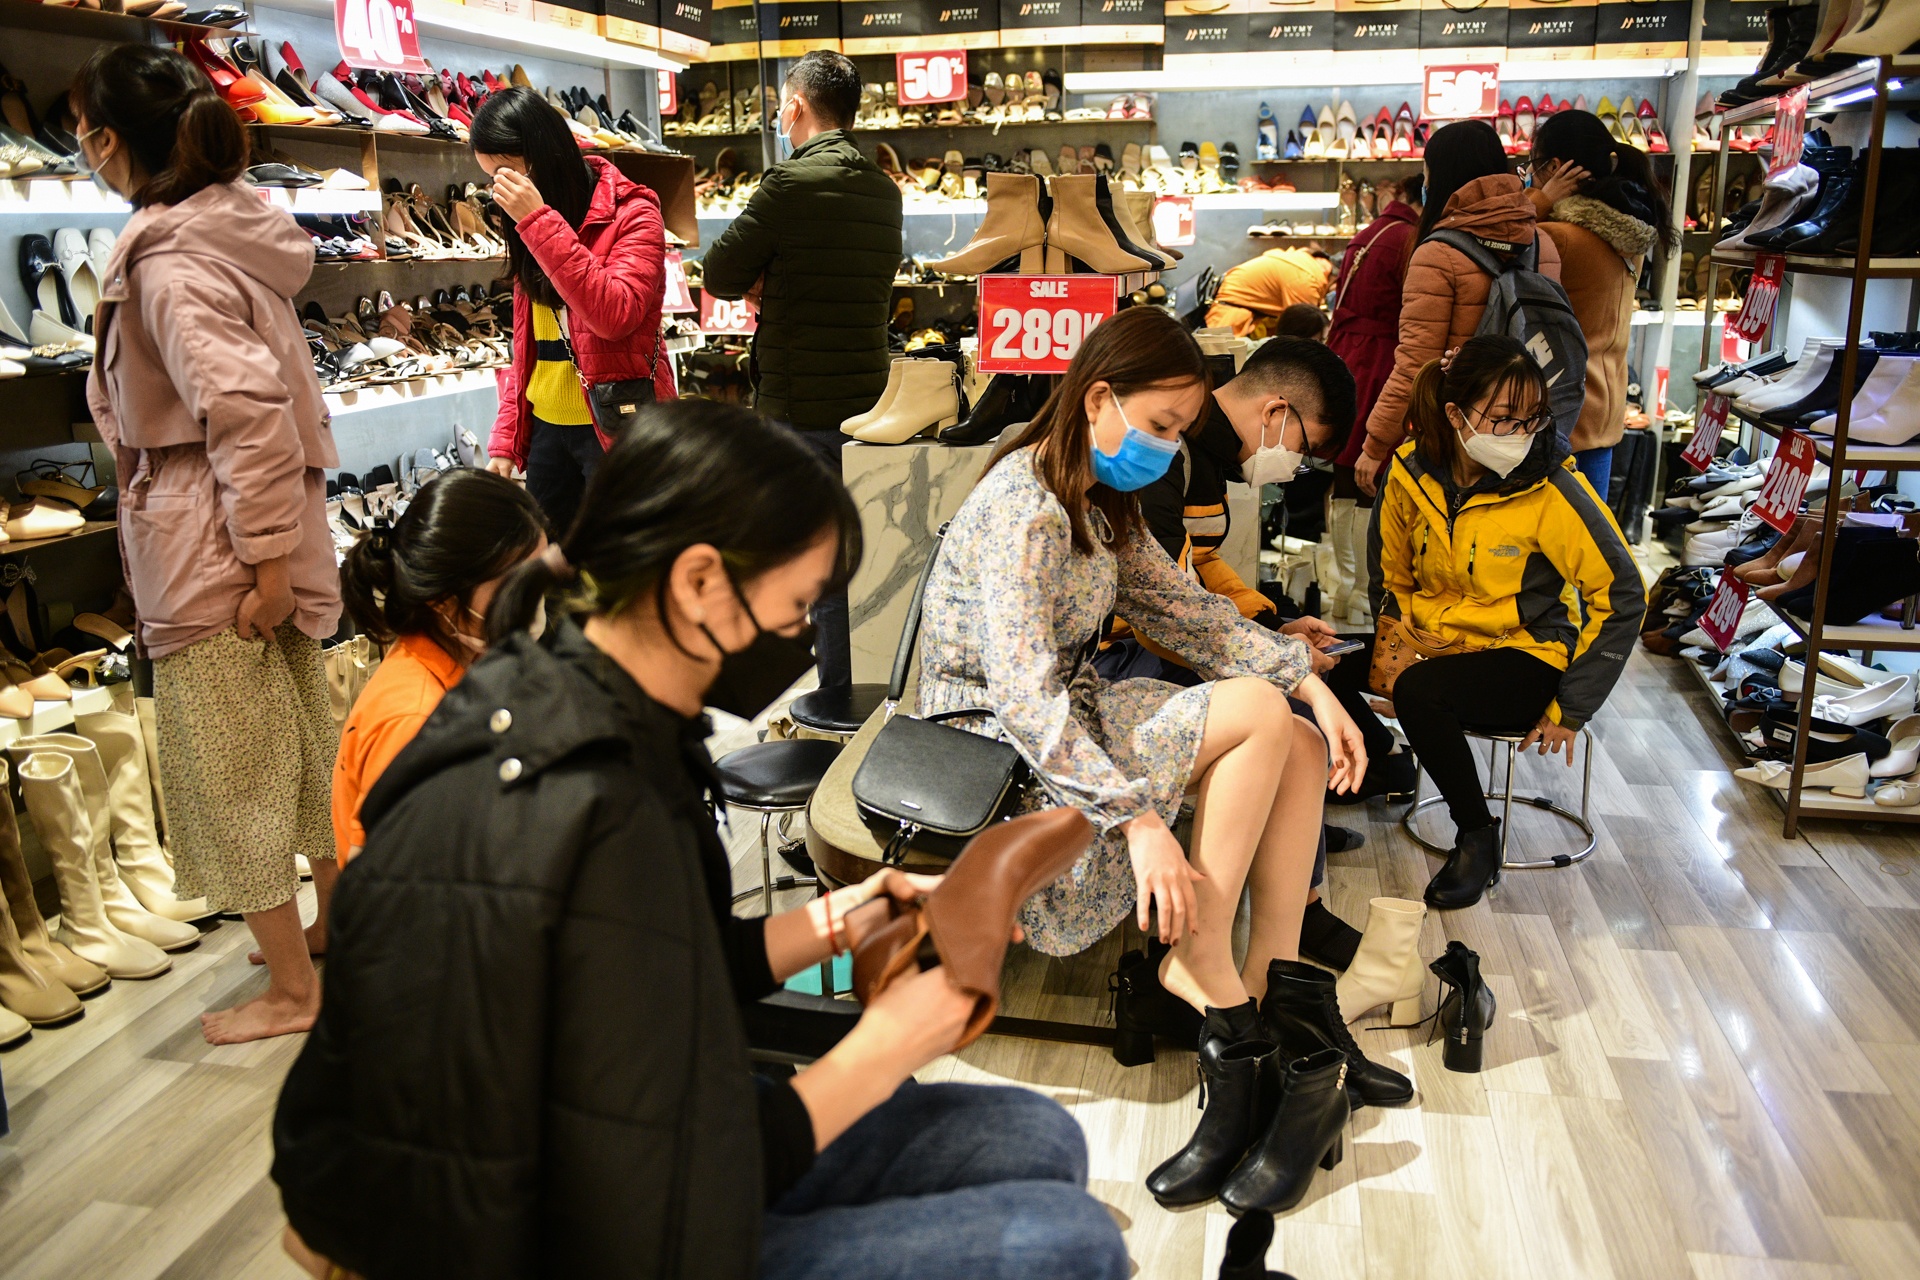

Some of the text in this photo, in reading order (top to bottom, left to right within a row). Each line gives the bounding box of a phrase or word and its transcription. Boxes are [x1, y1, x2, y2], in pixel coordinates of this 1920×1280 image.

[685, 5, 702, 16] MYMY
[952, 8, 979, 16] MYMY
[1543, 21, 1574, 29] MYMY
[343, 0, 413, 64] 40%
[903, 56, 964, 99] 50%
[1427, 70, 1497, 115] 50%
[1491, 241, 1511, 250] BECAUSE
[1030, 281, 1068, 298] SALE
[1685, 412, 1724, 462] 249K
[1790, 436, 1806, 459] SALE
[1756, 457, 1809, 520] 249K
[1708, 581, 1743, 633] 289K
